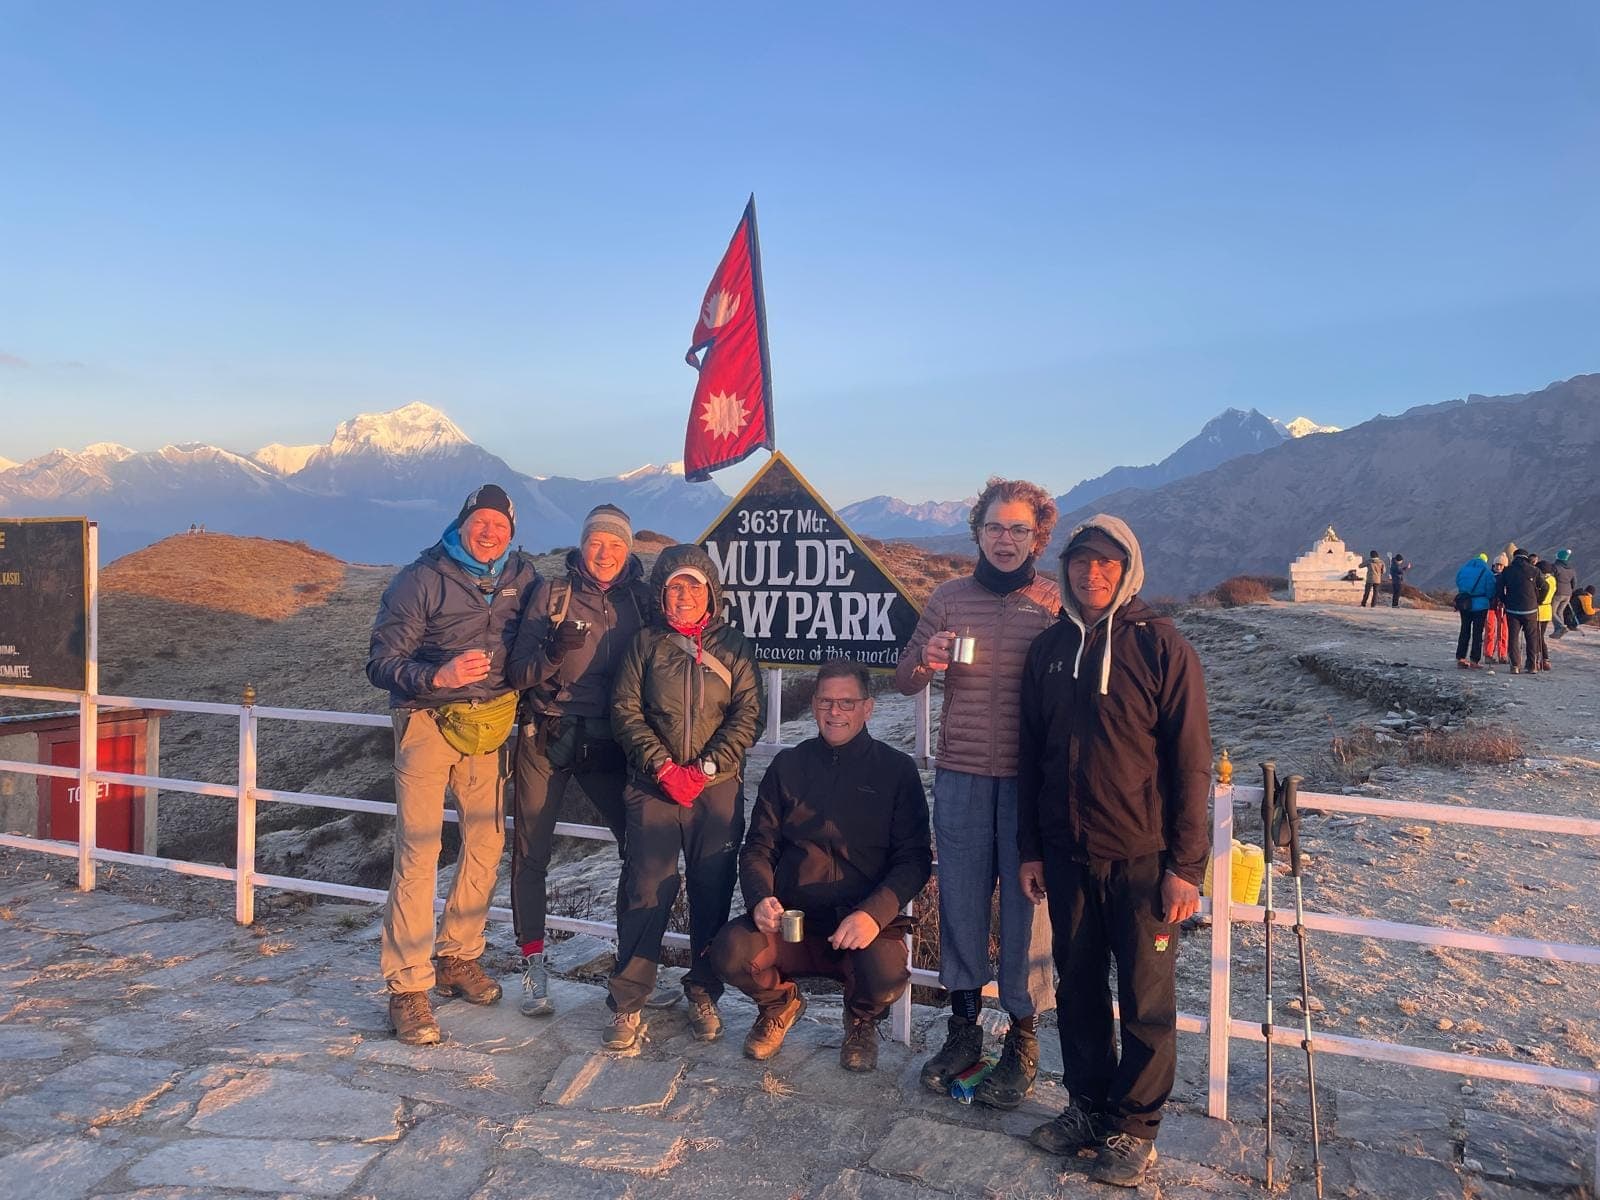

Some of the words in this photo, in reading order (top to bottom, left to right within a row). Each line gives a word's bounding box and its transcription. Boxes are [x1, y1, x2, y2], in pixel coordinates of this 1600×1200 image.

[738, 509, 793, 534] 3637
[797, 509, 830, 534] Mtr.
[706, 539, 855, 587] MULDE
[785, 591, 897, 641] PARK
[754, 643, 805, 661] heaven
[809, 644, 823, 661] of
[825, 645, 851, 661] this
[856, 647, 899, 665] world
[67, 782, 109, 804] TOET
